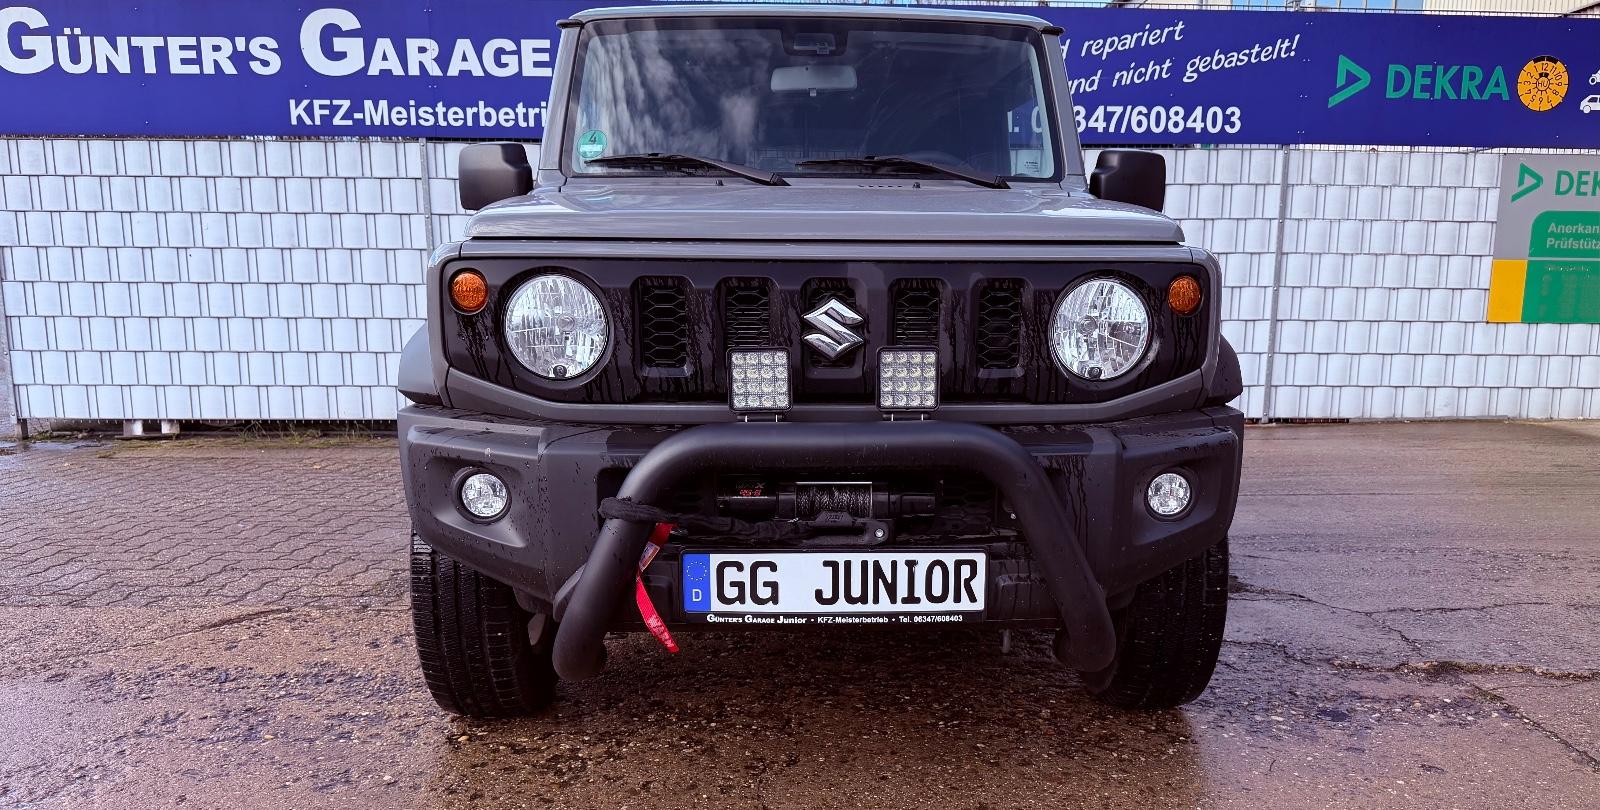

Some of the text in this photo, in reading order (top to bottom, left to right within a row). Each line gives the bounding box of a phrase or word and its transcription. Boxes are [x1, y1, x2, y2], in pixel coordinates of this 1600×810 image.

[0, 6, 552, 77] GÜNTER'S GARAGE
[1081, 21, 1185, 61] repariert
[1067, 33, 1300, 95] nd nicht gebastelt!
[1385, 64, 1510, 100] DEKRA
[289, 99, 548, 128] KFZ-Meisterbetri
[588, 131, 597, 145] 4
[1554, 169, 1600, 197] DEK
[692, 588, 702, 602] D
[716, 559, 978, 606] GG JUNIOR
[744, 614, 775, 624] GARAGE
[776, 615, 808, 624] Junior
[817, 616, 889, 624] KFZ-Meisterbetrieb
[898, 615, 912, 623] Tel.
[913, 614, 963, 623] 06347/608403
